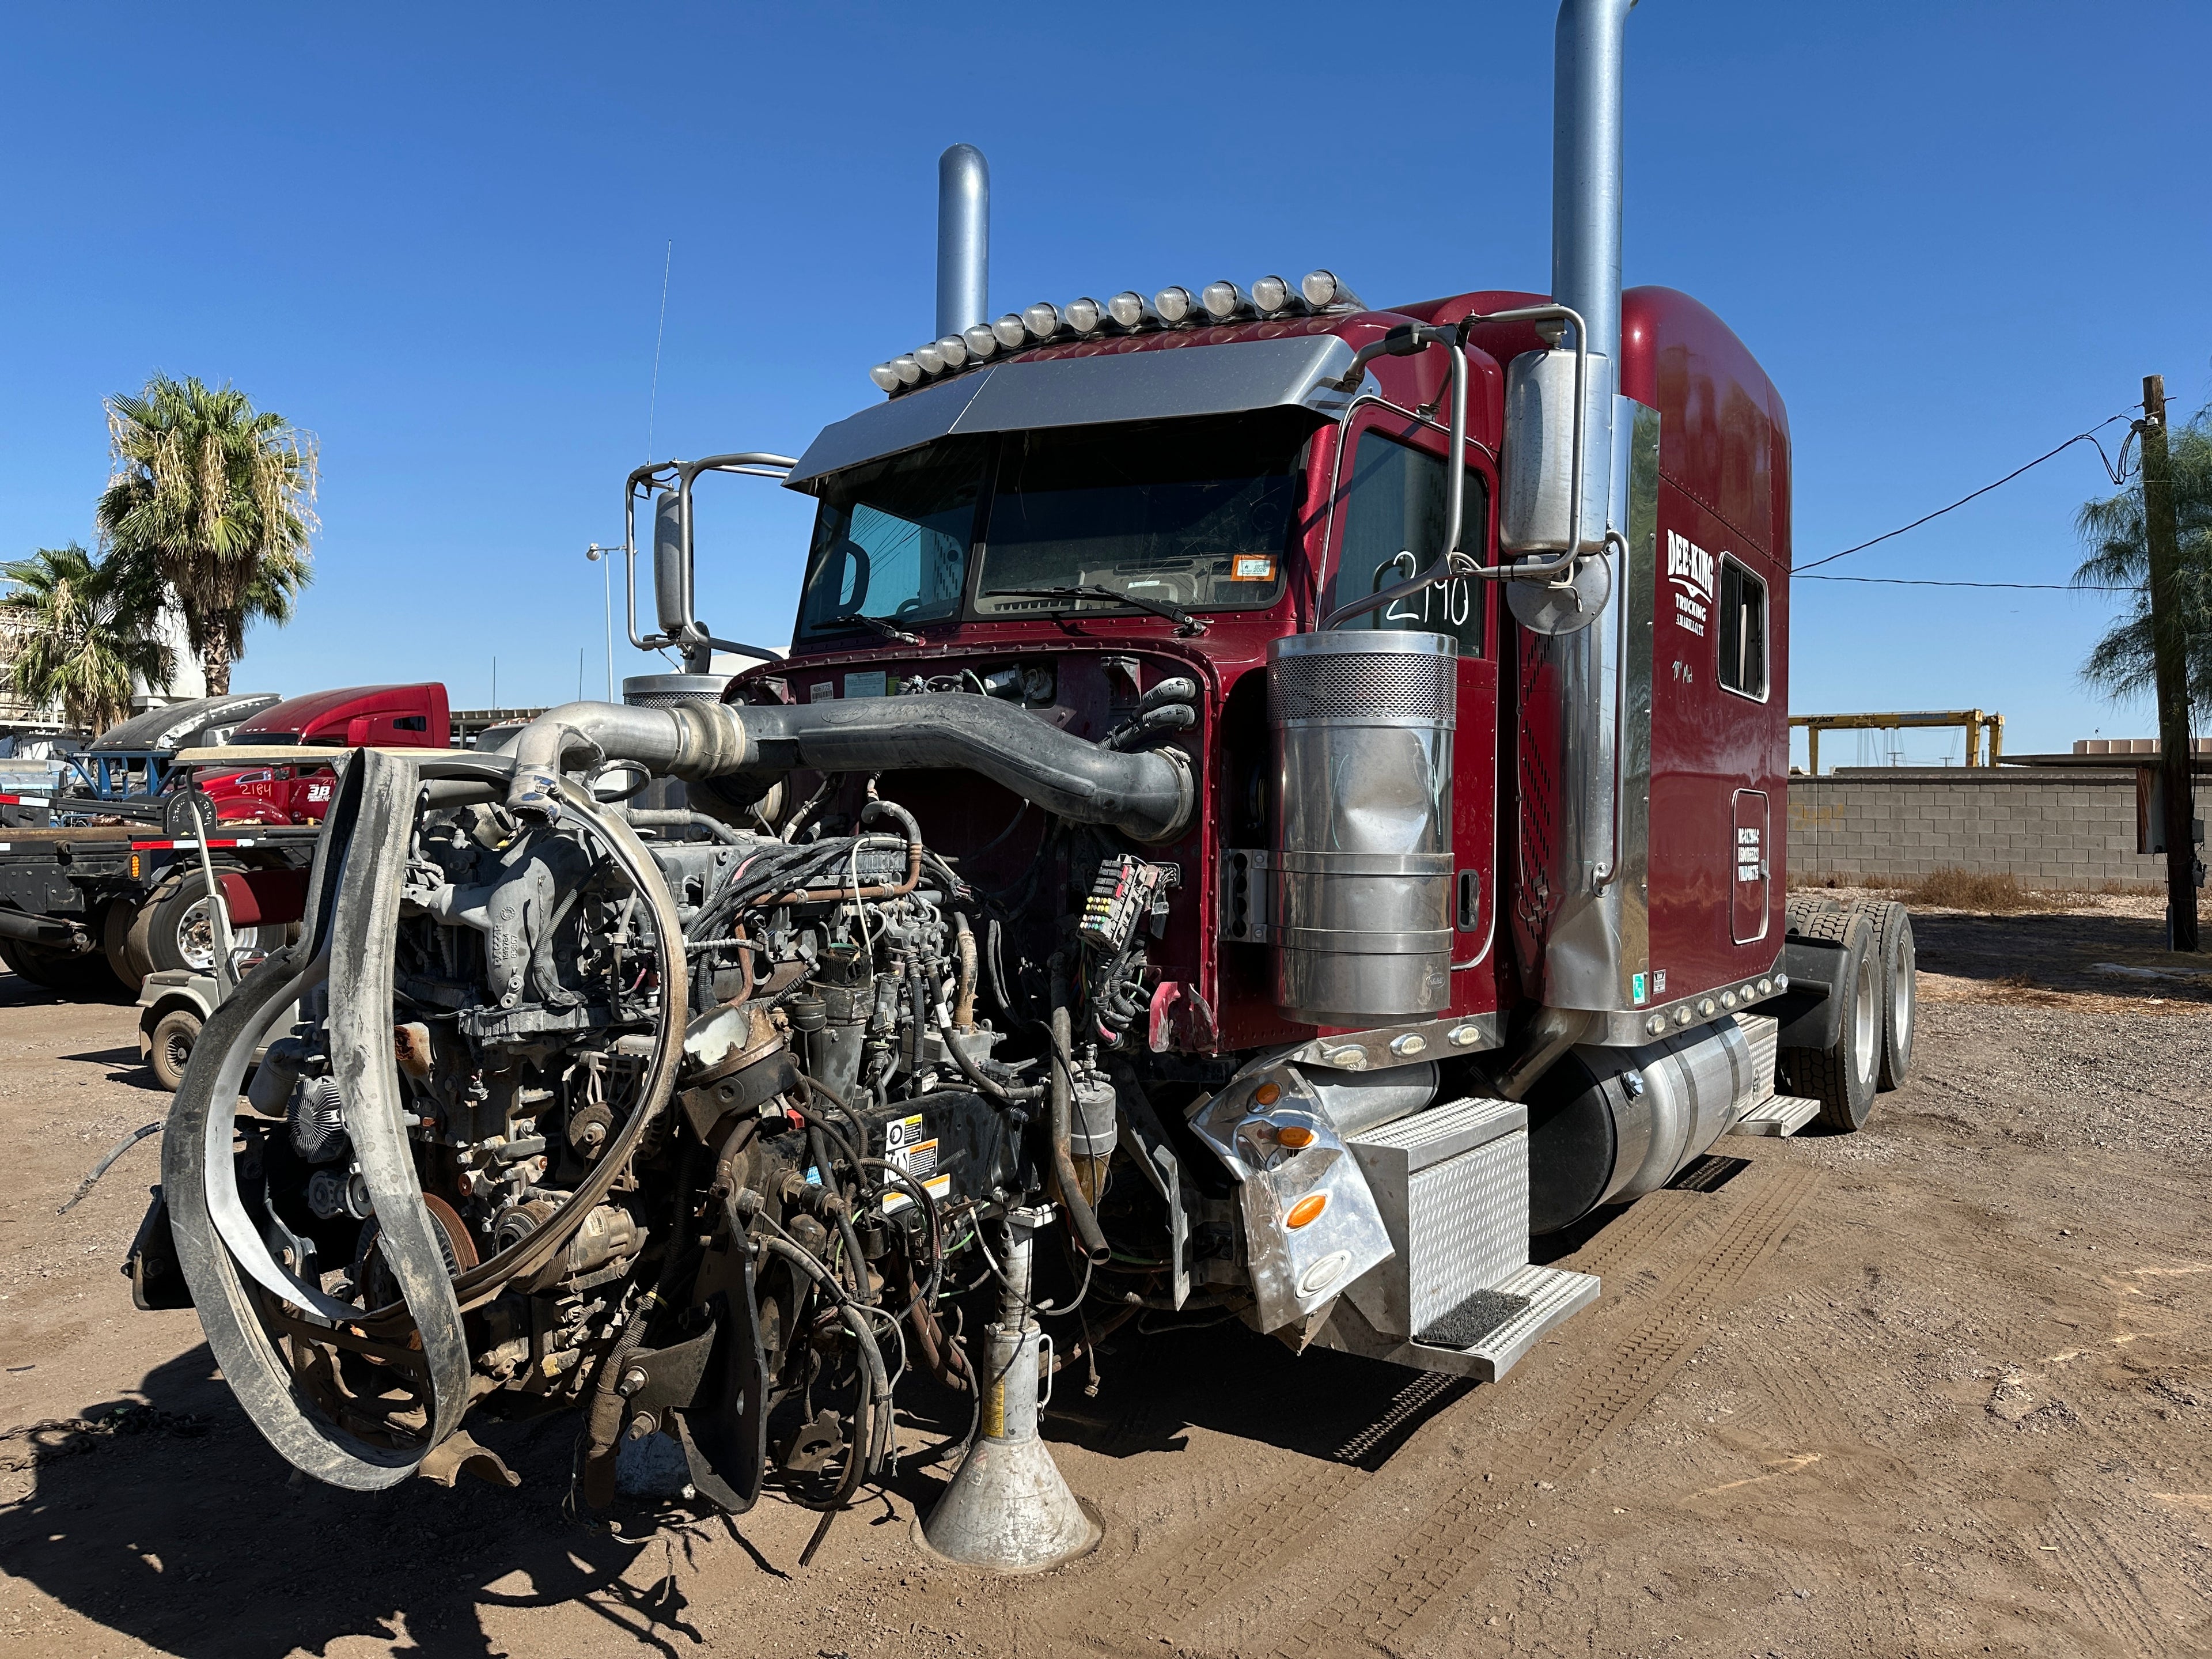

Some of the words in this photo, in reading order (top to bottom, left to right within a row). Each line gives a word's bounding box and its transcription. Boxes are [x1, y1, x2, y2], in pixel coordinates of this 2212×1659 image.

[1675, 593, 1706, 622] TRUCKING
[813, 684, 831, 692] 486775
[308, 786, 331, 796] 3B
[491, 923, 503, 969] PACCAR
